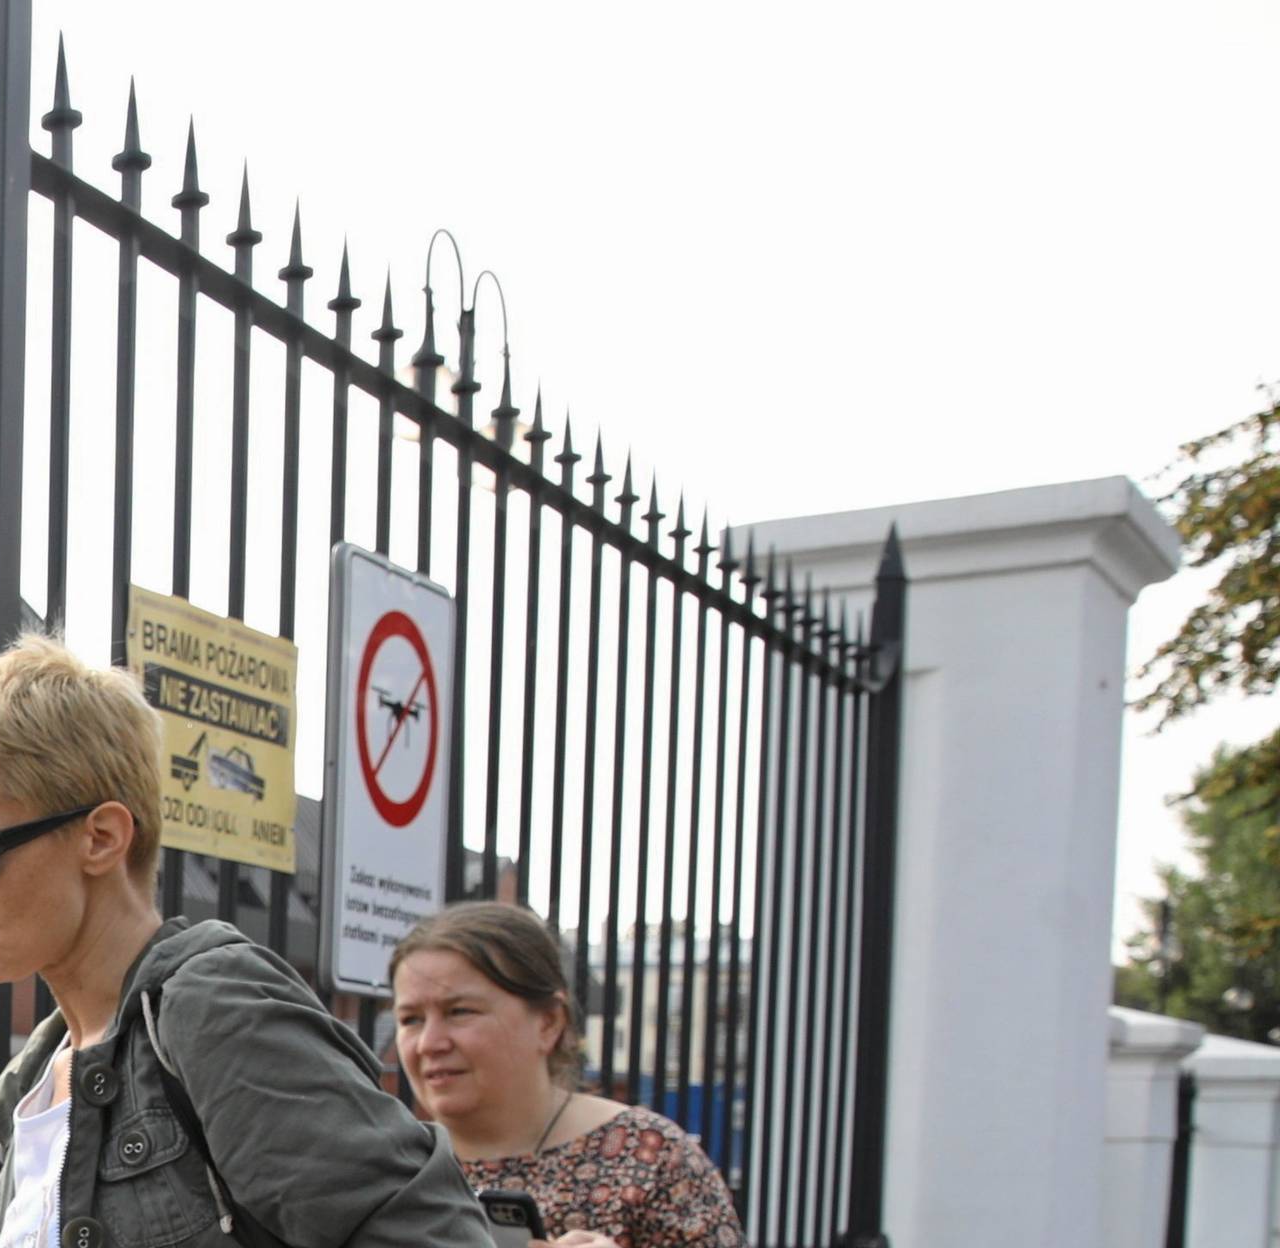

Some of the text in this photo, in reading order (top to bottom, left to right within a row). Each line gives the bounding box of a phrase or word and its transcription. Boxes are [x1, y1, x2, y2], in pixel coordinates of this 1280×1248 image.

[142, 620, 202, 671] BRAMA
[205, 641, 289, 694] POŻAROWA
[159, 673, 280, 740] NIE ZASTAWIAĆ
